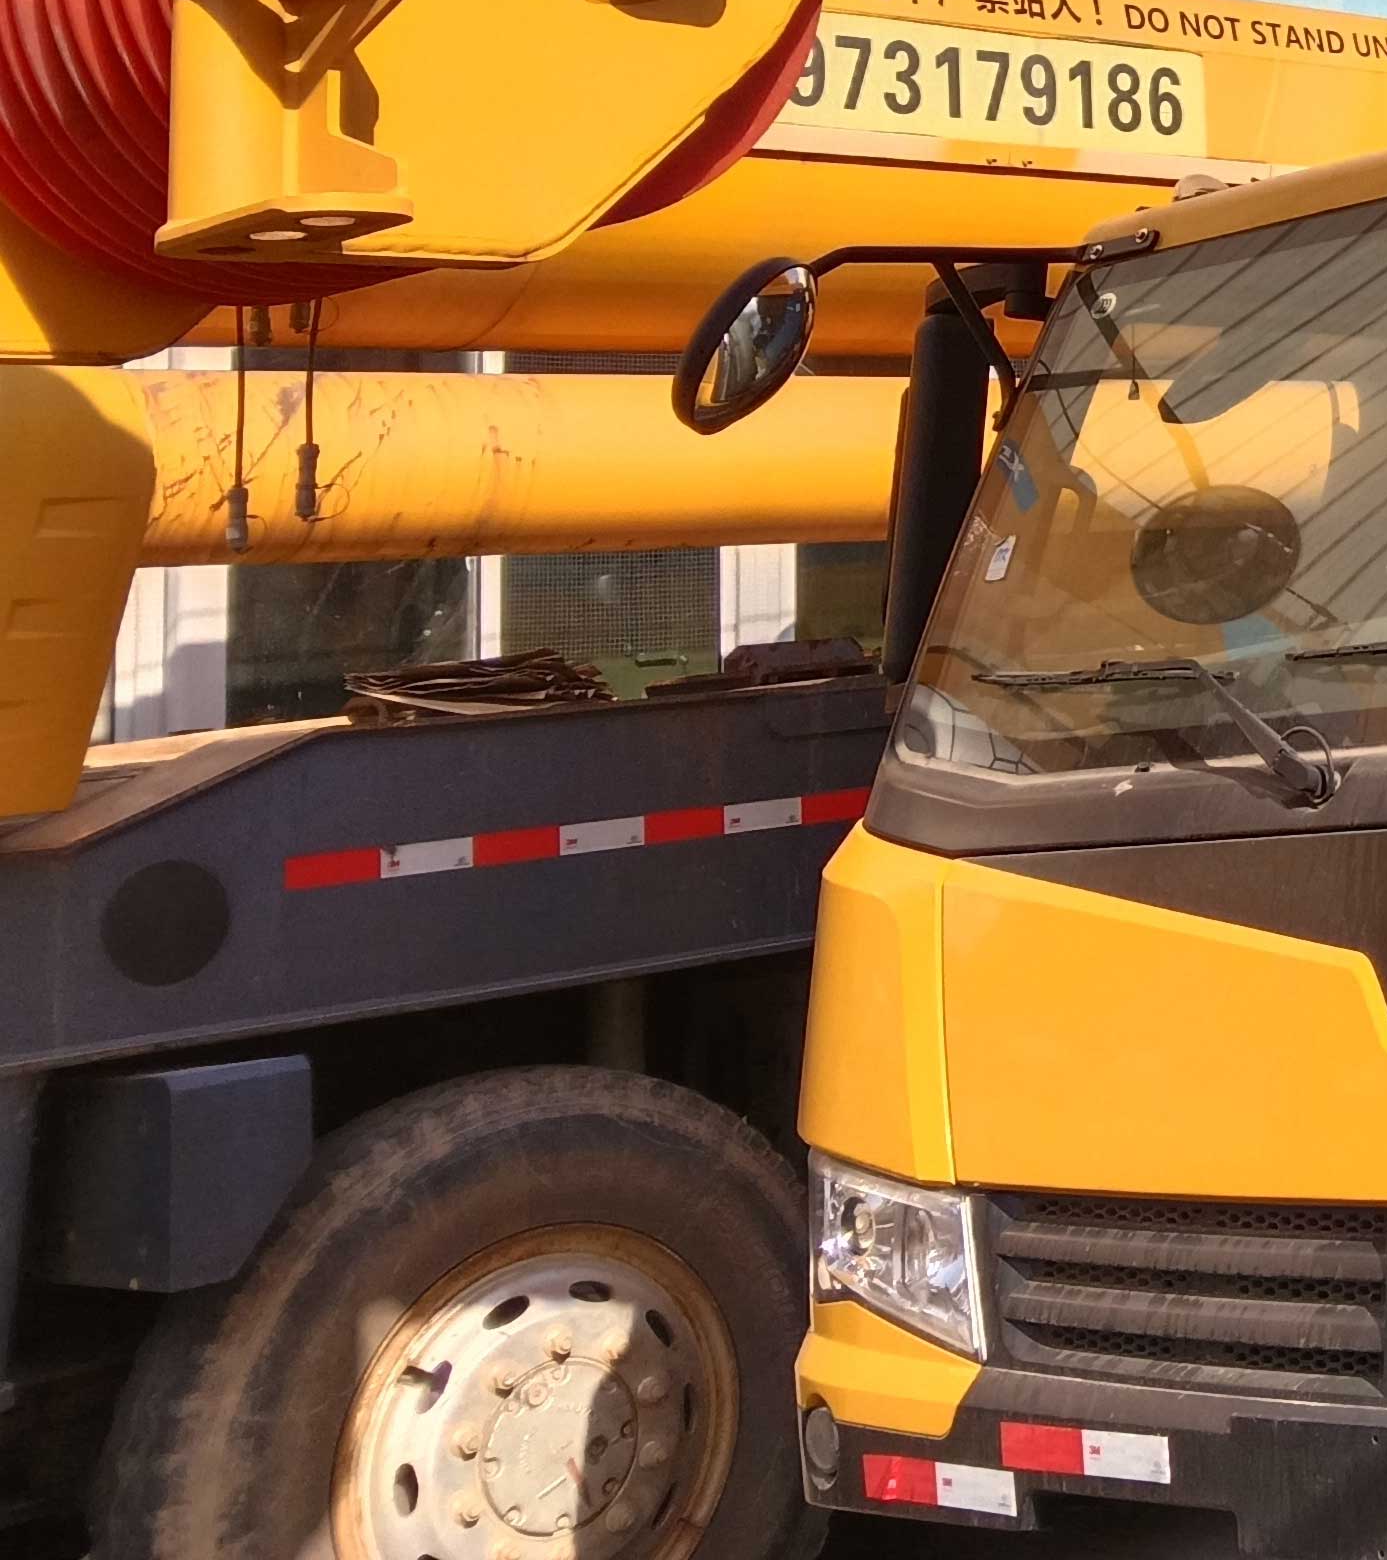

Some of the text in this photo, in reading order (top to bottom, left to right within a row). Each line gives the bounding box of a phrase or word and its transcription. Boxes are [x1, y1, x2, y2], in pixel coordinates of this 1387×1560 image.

[1124, 3, 1169, 33] DO
[1179, 10, 1241, 41] NOT
[1250, 20, 1345, 54] STAND
[789, 33, 1184, 136] 973179186
